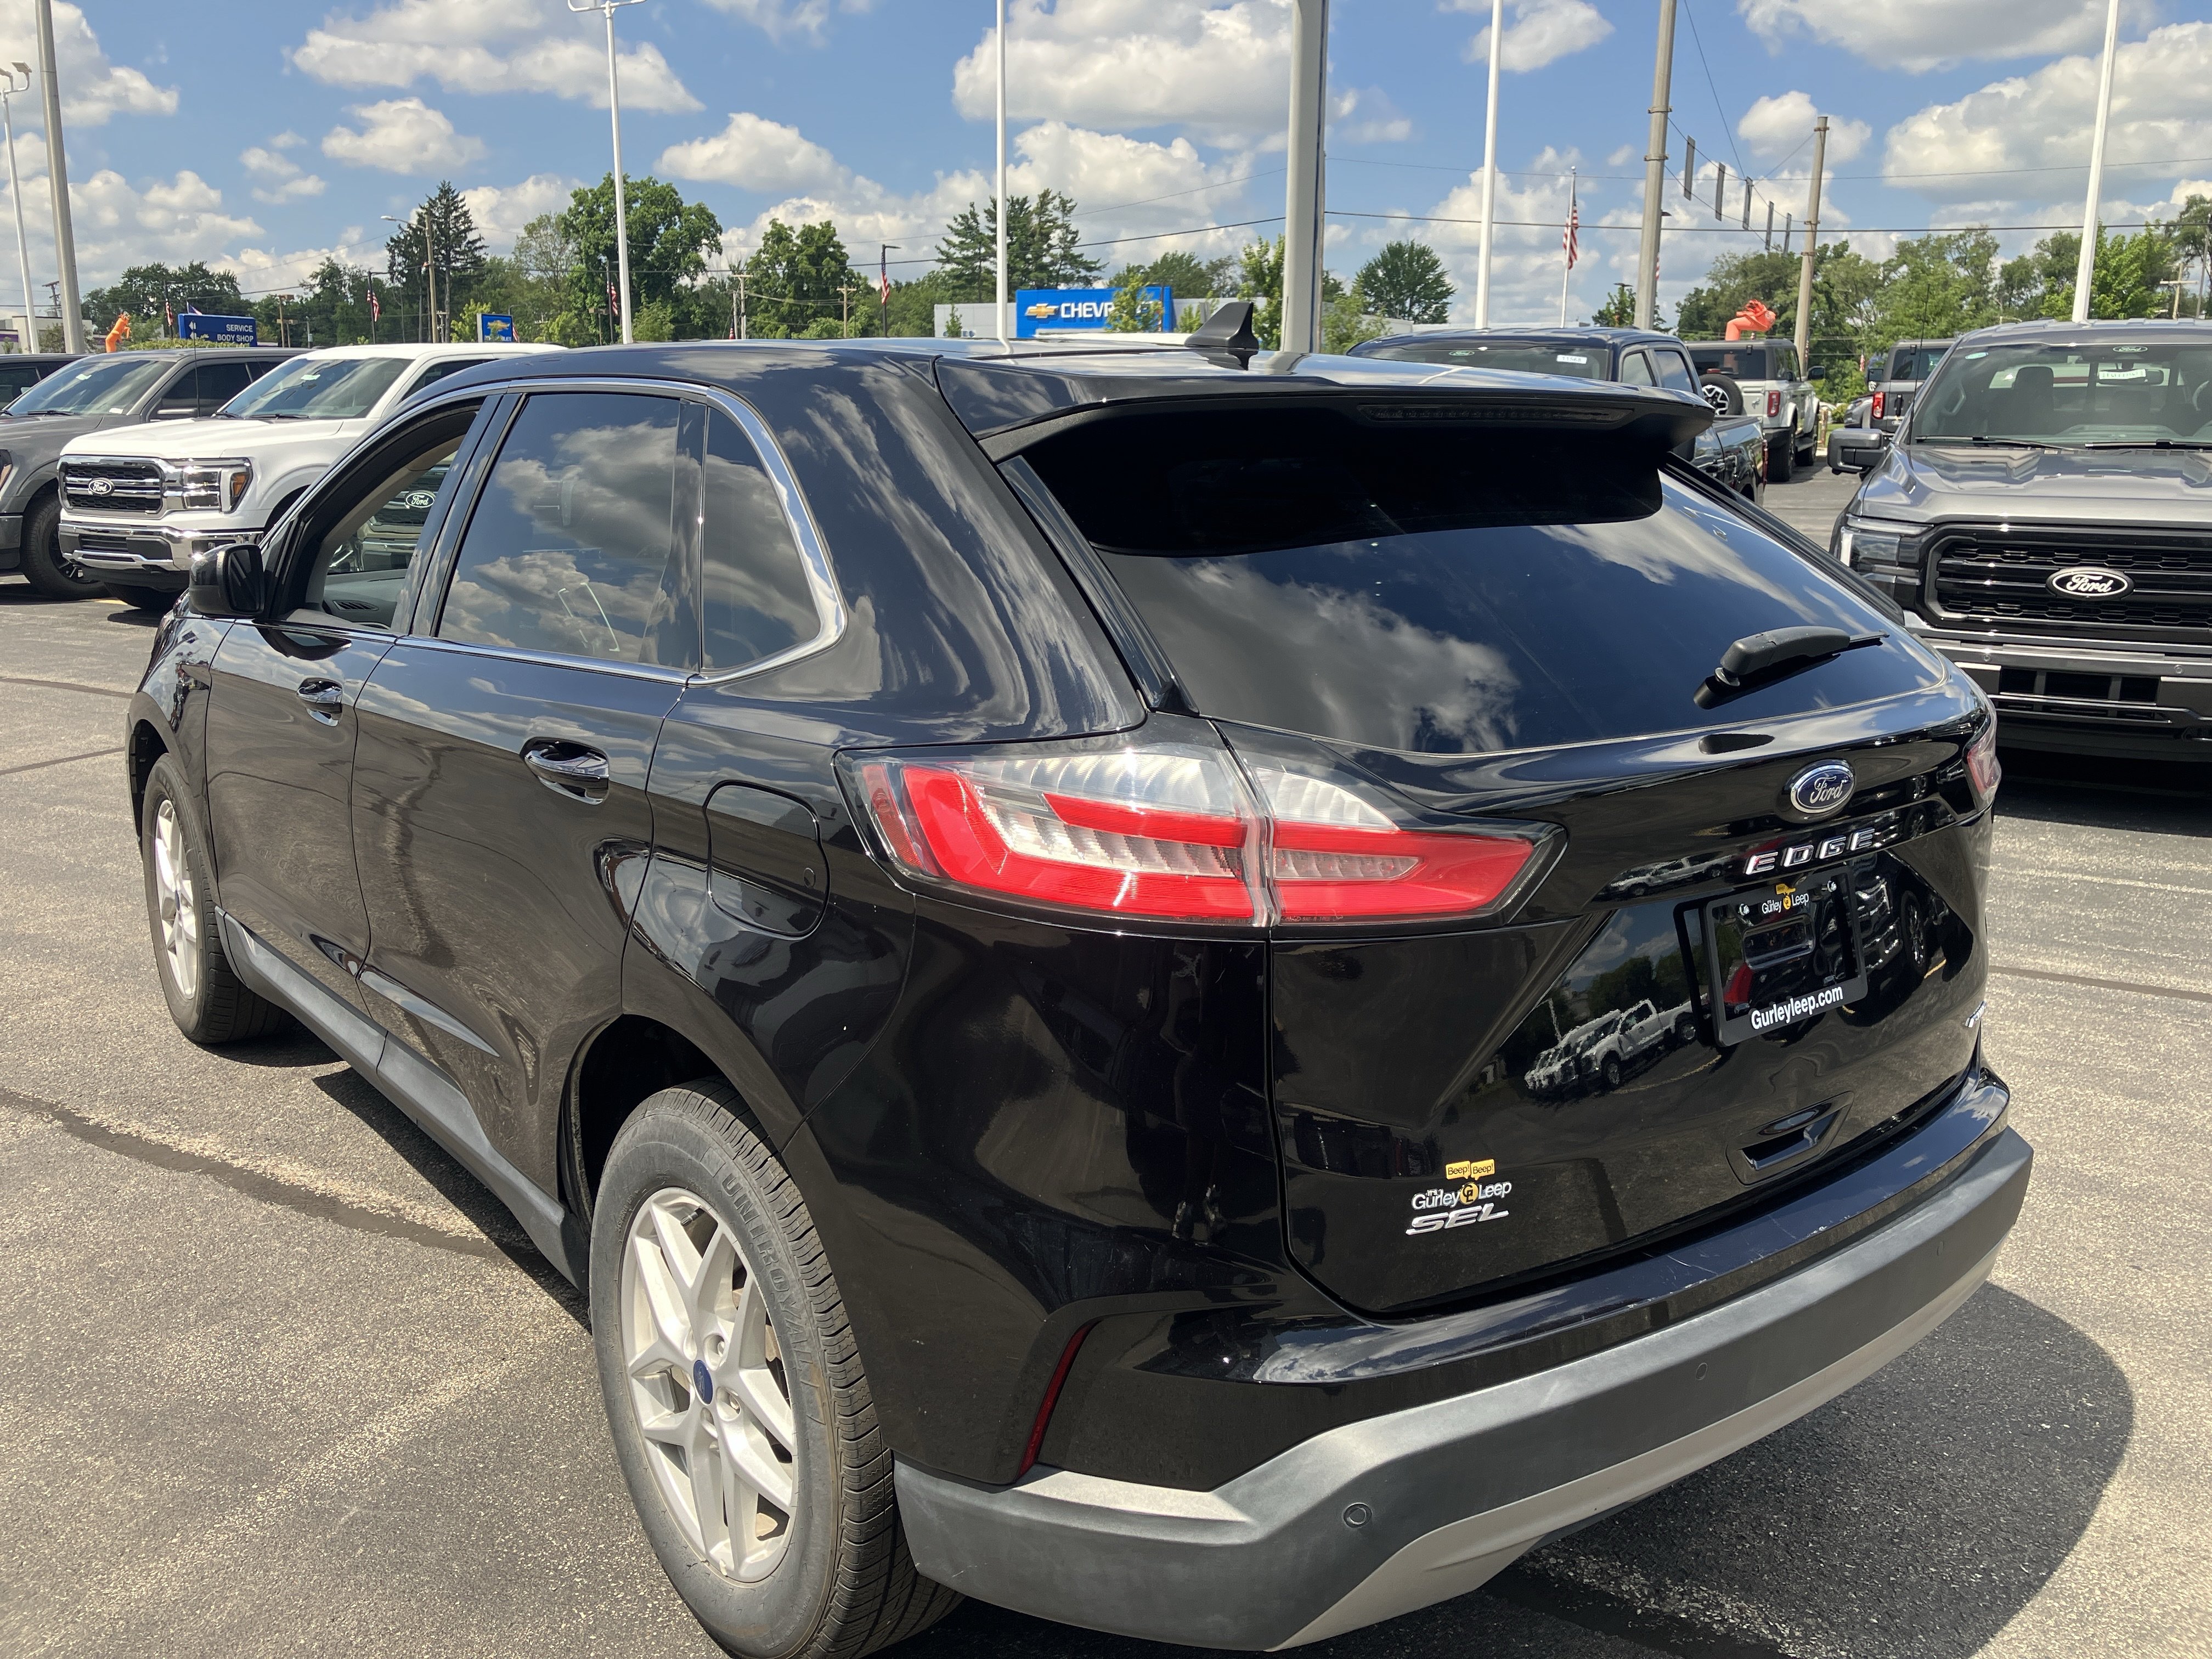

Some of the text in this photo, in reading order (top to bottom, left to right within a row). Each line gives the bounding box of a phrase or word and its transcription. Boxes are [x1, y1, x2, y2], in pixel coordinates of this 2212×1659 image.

[226, 324, 253, 332] SERVICE
[2066, 574, 2113, 592] Ford
[1810, 775, 1843, 804] Ford
[1745, 827, 1875, 875] EDGE
[1762, 900, 1782, 914] Gurley
[1791, 893, 1809, 906] Leep
[1751, 986, 1843, 1029] Gurleyleep.com
[1448, 1163, 1494, 1176] Beep! Beep!
[1412, 1189, 1460, 1210] Gurley
[1479, 1182, 1512, 1199] Leep
[1406, 1203, 1509, 1235] SEL
[721, 1174, 814, 1371] UNIROYAL
